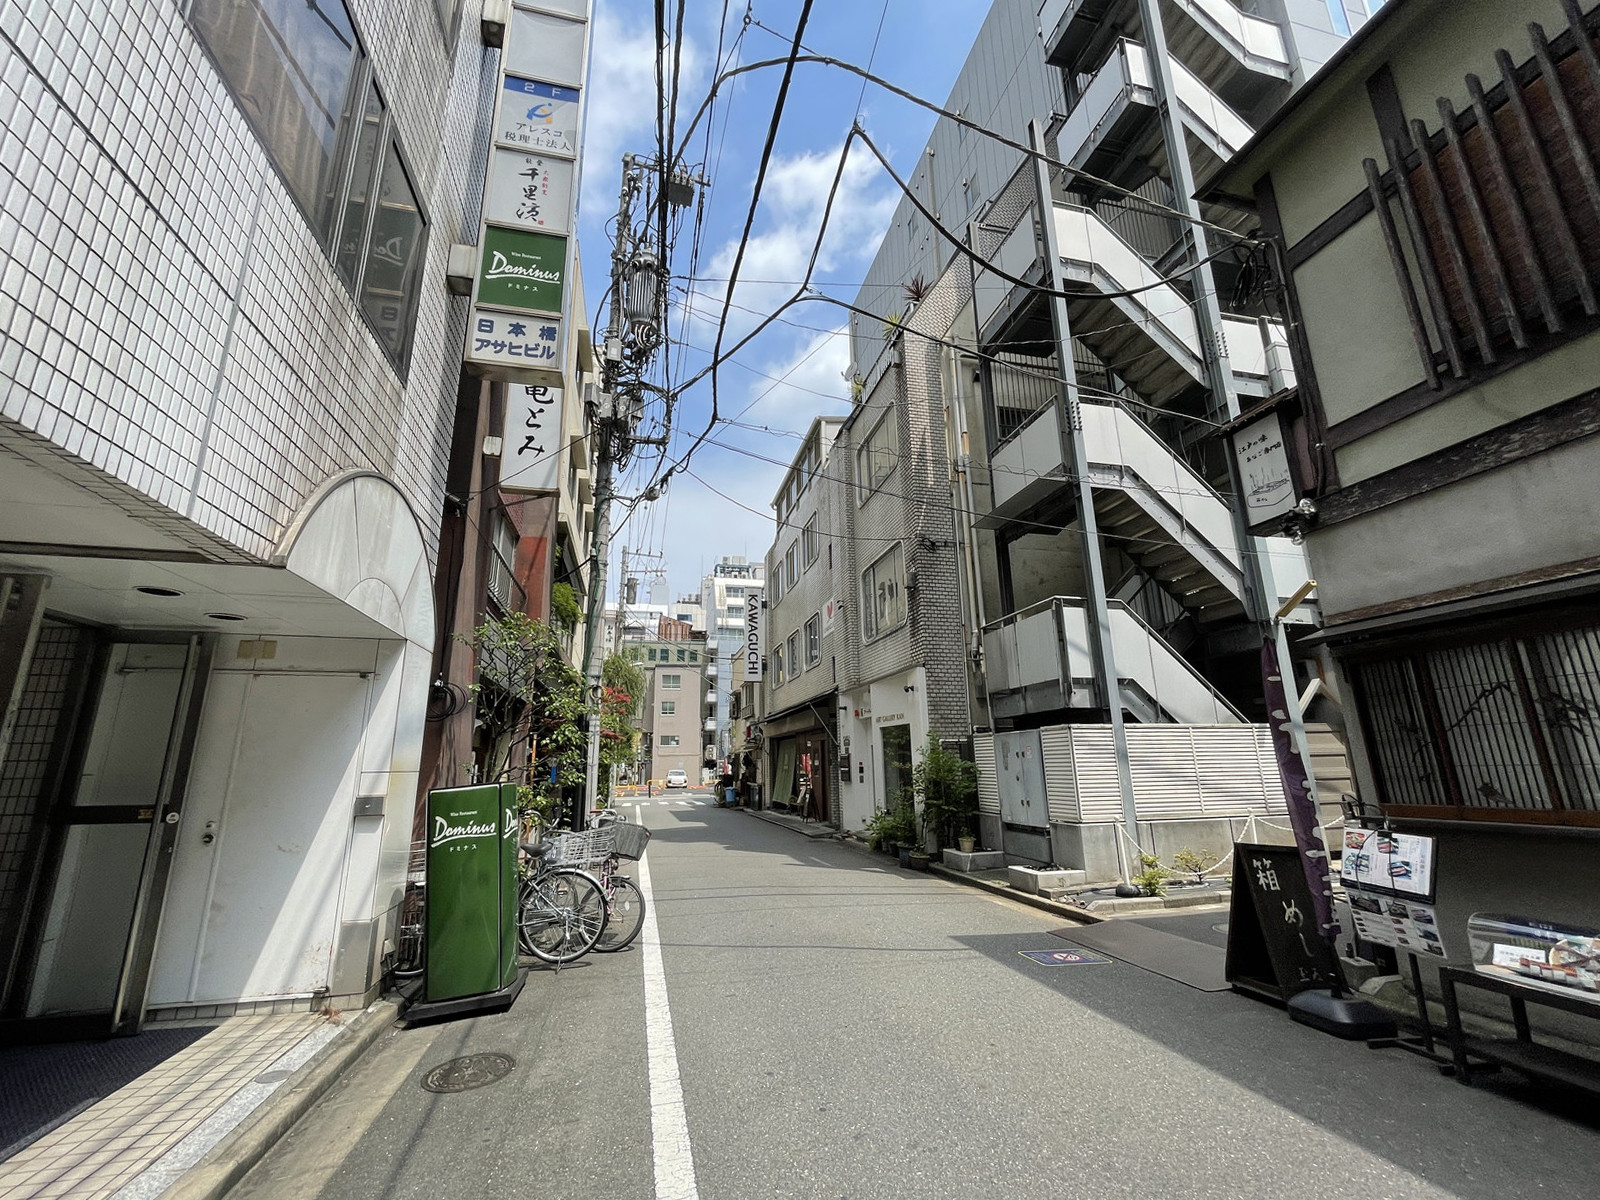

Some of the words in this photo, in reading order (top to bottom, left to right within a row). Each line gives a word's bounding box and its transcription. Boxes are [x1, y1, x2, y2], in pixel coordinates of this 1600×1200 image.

[505, 131, 571, 151] 税理士法人
[516, 122, 562, 138] アレスコ
[487, 250, 560, 282] Dominus
[507, 282, 539, 292] ドミナス
[478, 318, 557, 342] 日本橋
[474, 338, 555, 360] アサヒビル
[748, 594, 759, 675] KAWAGUCHI
[431, 815, 497, 844] Dominus
[449, 843, 478, 853] ドミナス
